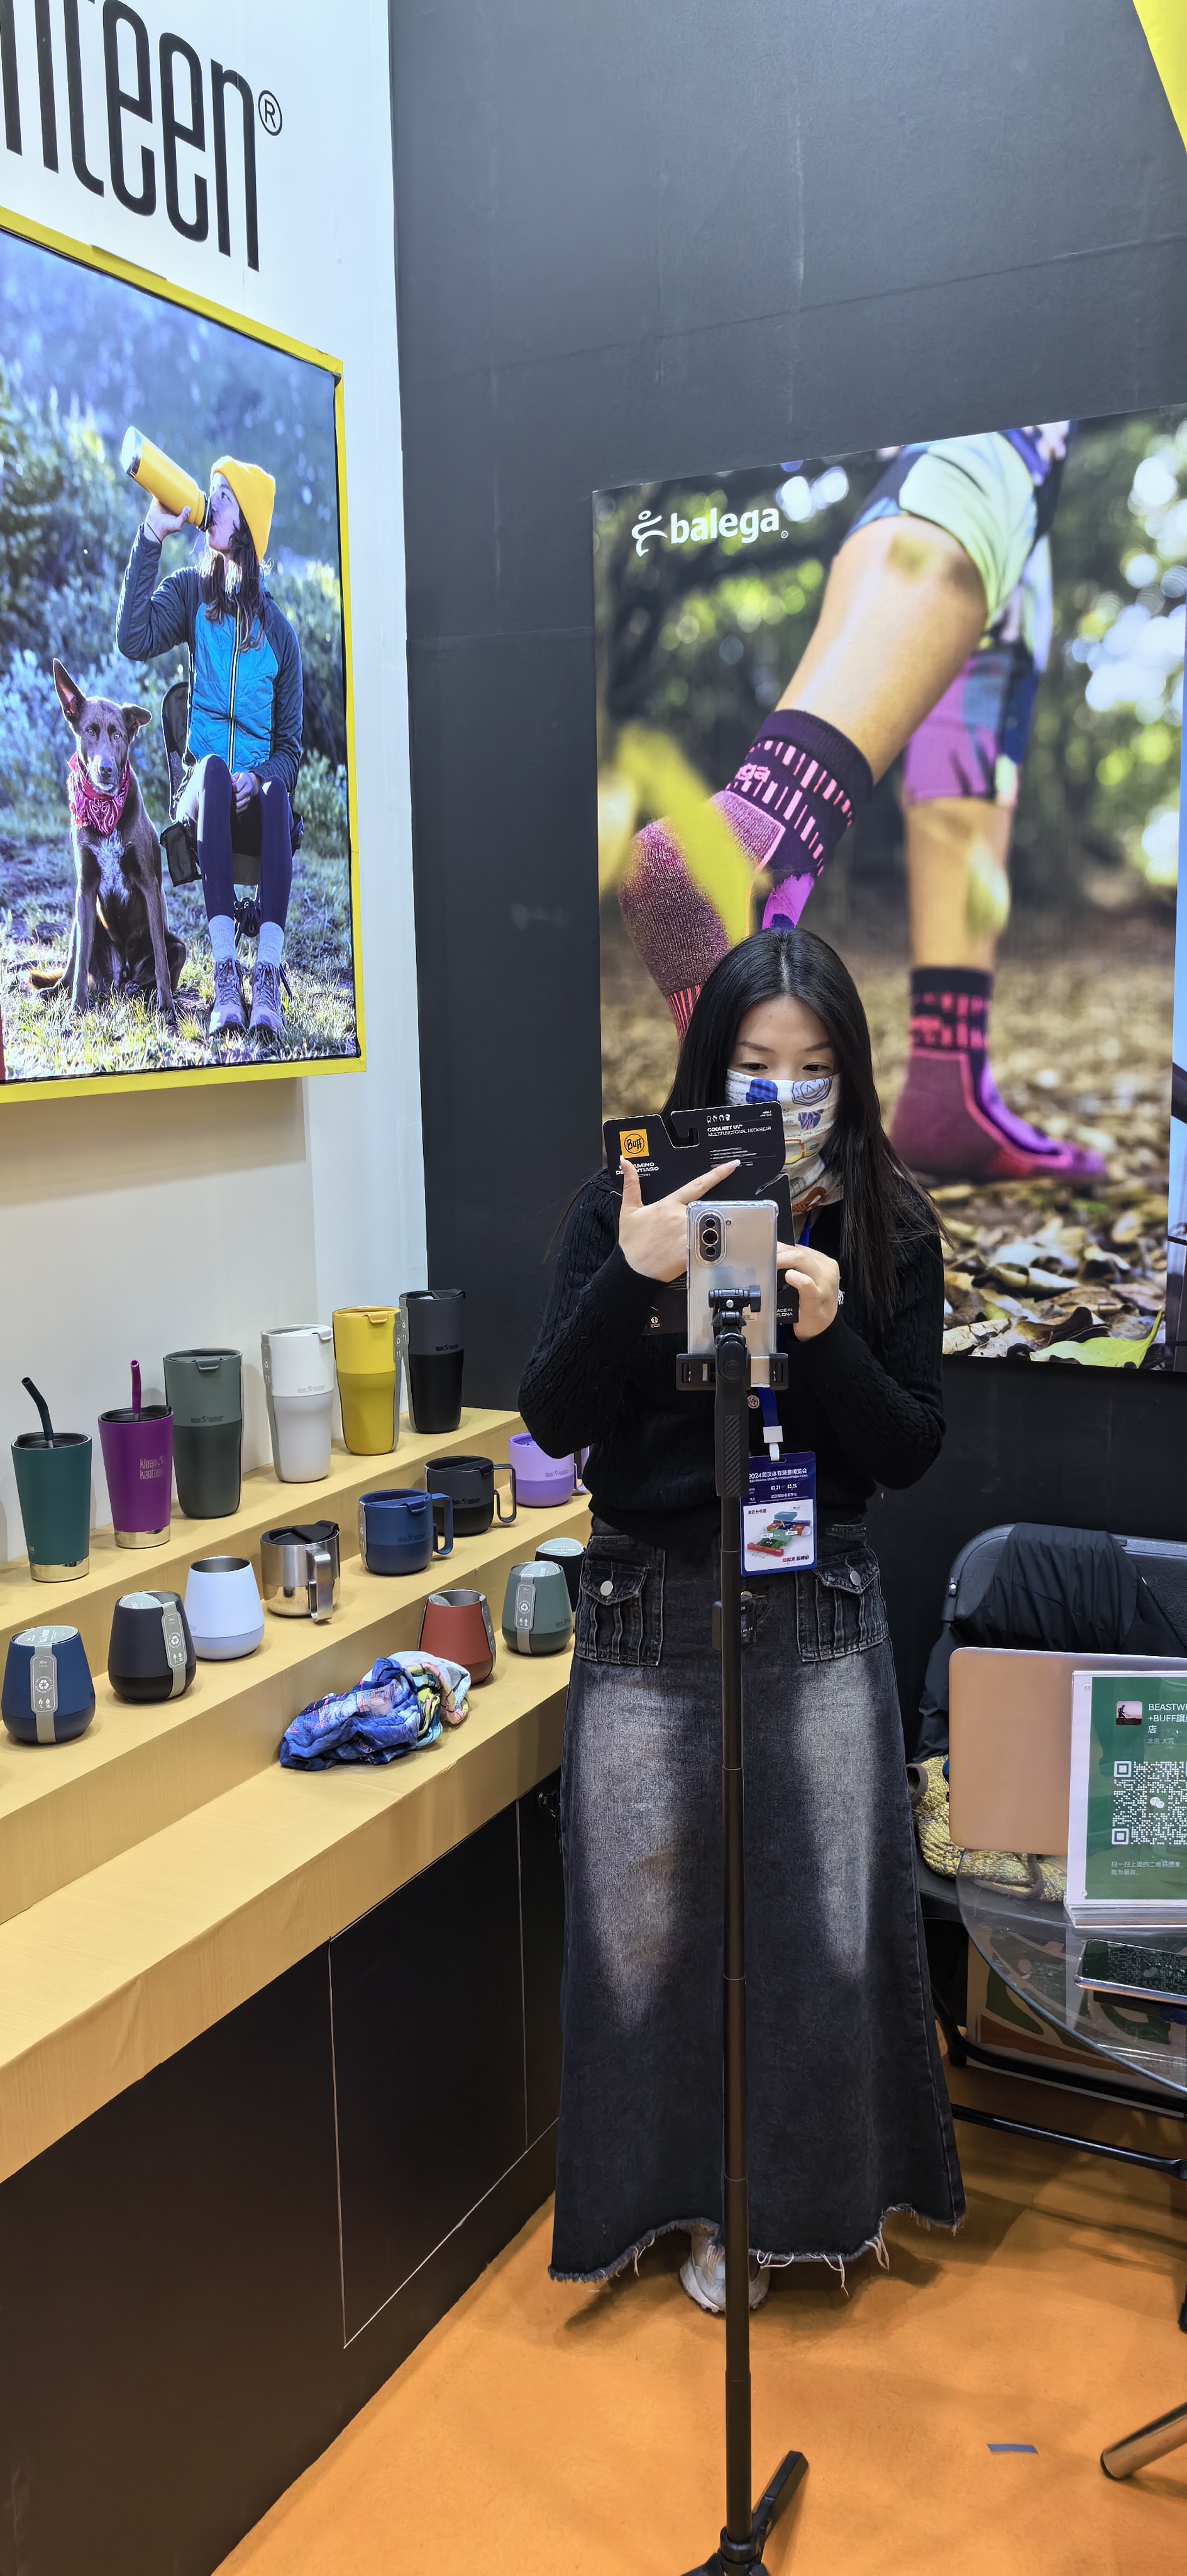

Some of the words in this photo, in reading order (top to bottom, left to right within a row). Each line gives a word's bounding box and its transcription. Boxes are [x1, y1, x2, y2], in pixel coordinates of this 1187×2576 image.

[626, 1138, 642, 1150] Buff
[1148, 1714, 1187, 1723] +BUFF旗
[1147, 1725, 1157, 1734] 店
